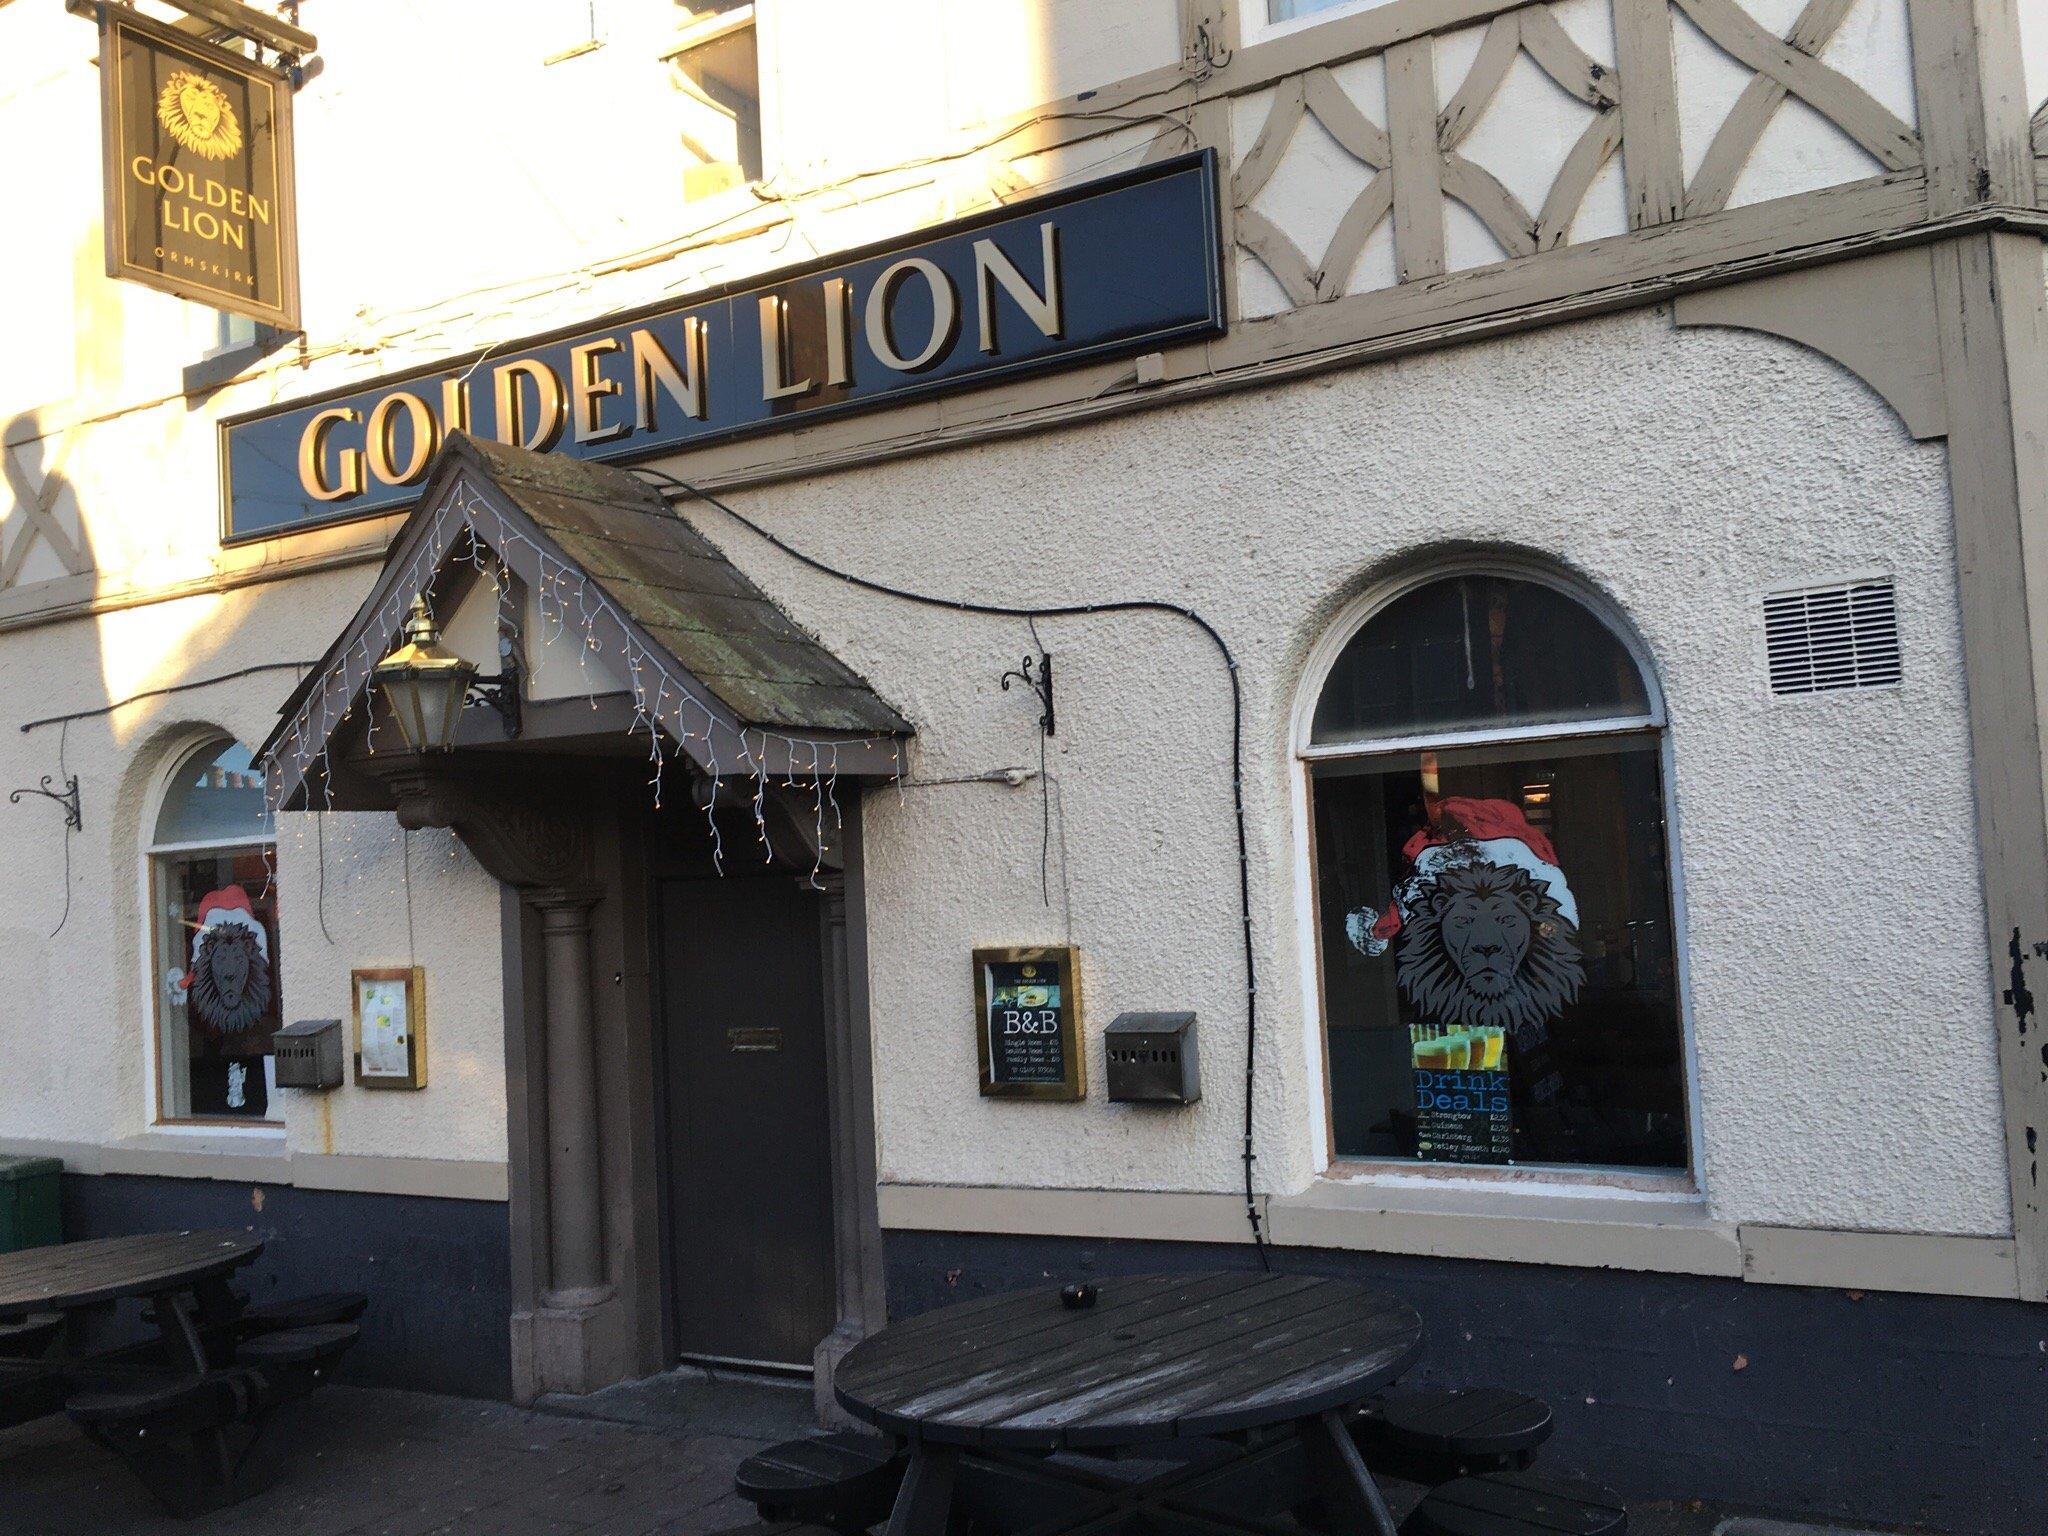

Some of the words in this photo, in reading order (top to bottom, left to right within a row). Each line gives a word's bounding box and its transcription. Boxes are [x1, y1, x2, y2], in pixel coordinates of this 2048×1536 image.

[131, 155, 270, 226] GOLDEN
[163, 198, 244, 250] LION
[154, 246, 256, 286] ORMSKIRK
[758, 221, 1062, 401] LION
[1003, 1009, 1058, 1034] B&B
[1415, 1069, 1511, 1091] Drink
[1416, 1090, 1508, 1111] Deals
[1431, 1111, 1472, 1121] Strongbow
[1432, 1132, 1473, 1143] Carlsberg
